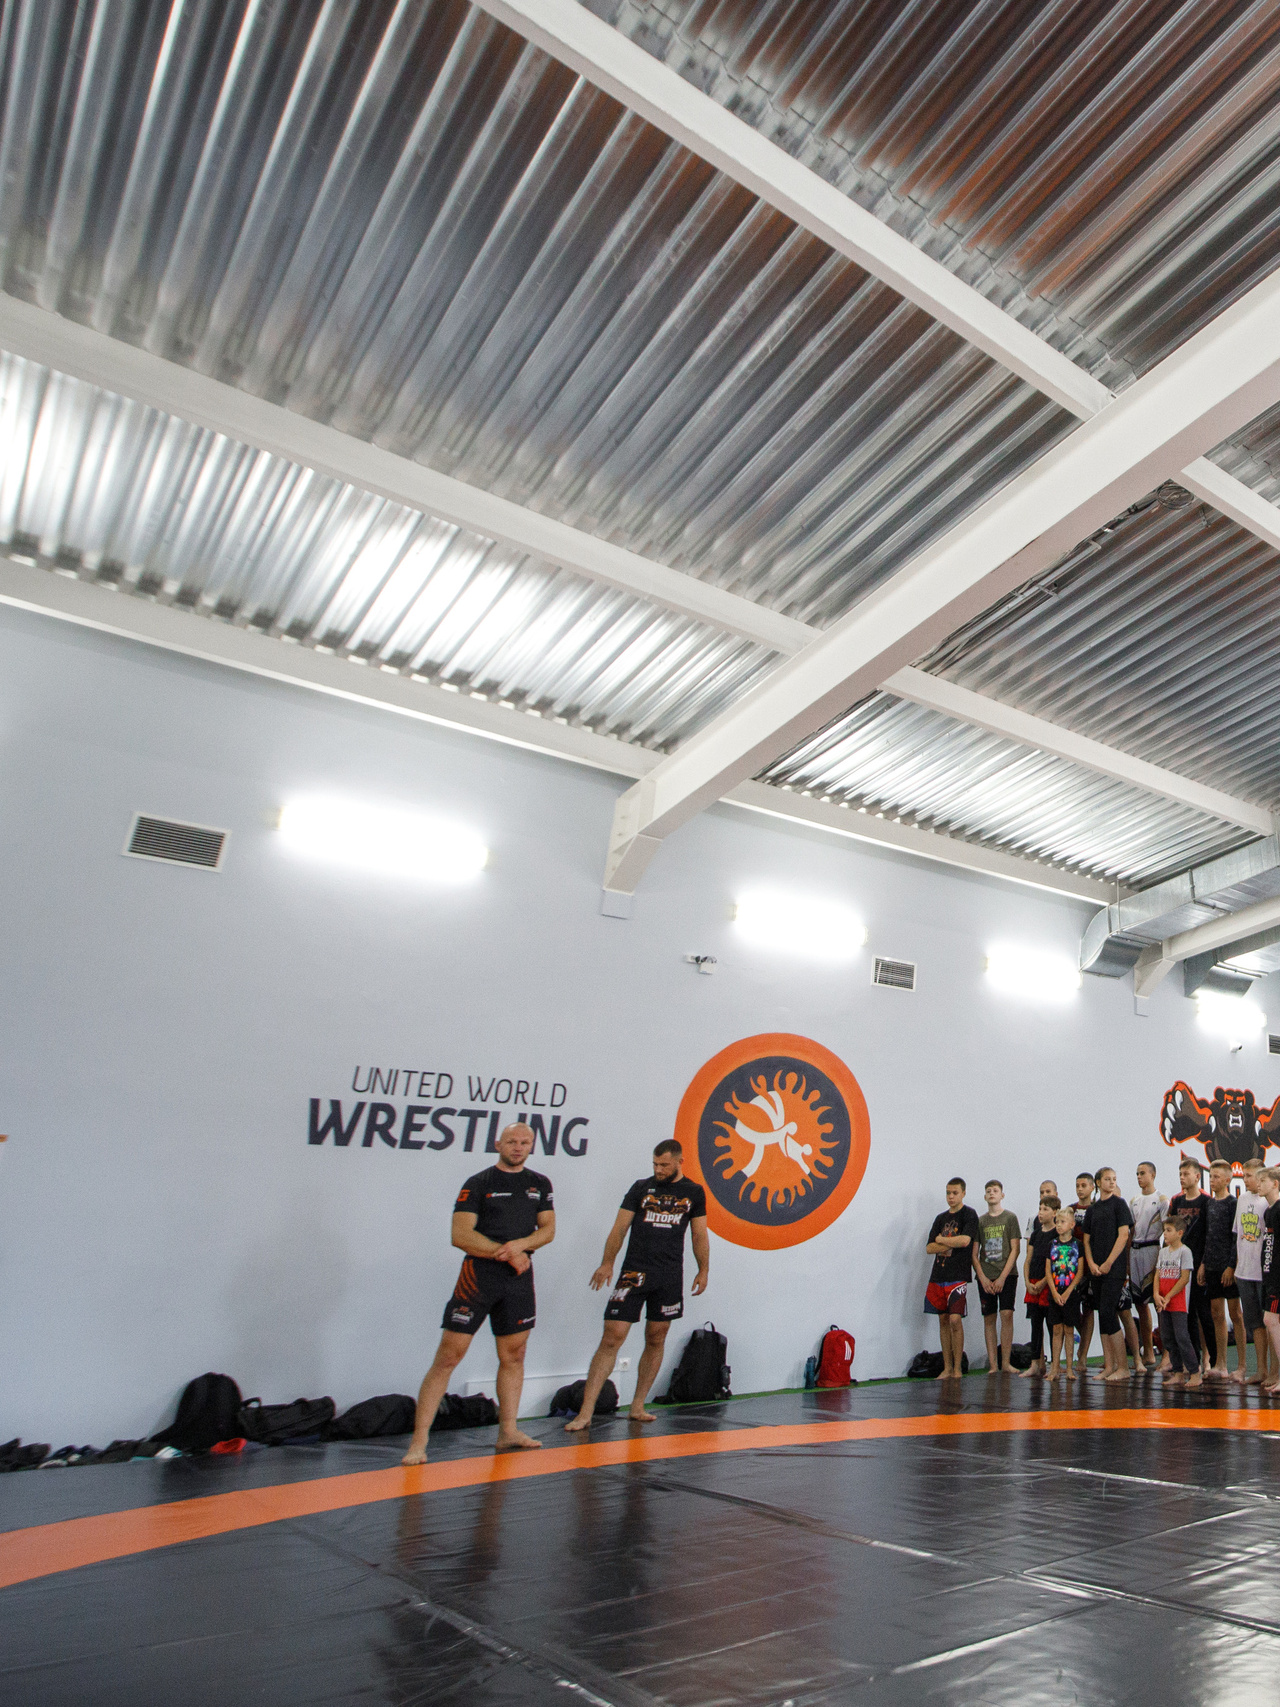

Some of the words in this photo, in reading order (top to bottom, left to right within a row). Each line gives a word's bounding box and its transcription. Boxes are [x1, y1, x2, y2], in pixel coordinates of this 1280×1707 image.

[352, 1065, 454, 1099] UNITED
[468, 1075, 568, 1108] WORLD
[307, 1097, 590, 1157] WRESTLNG
[644, 1210, 683, 1225] ШТОРМ
[1263, 1234, 1273, 1272] Reebok
